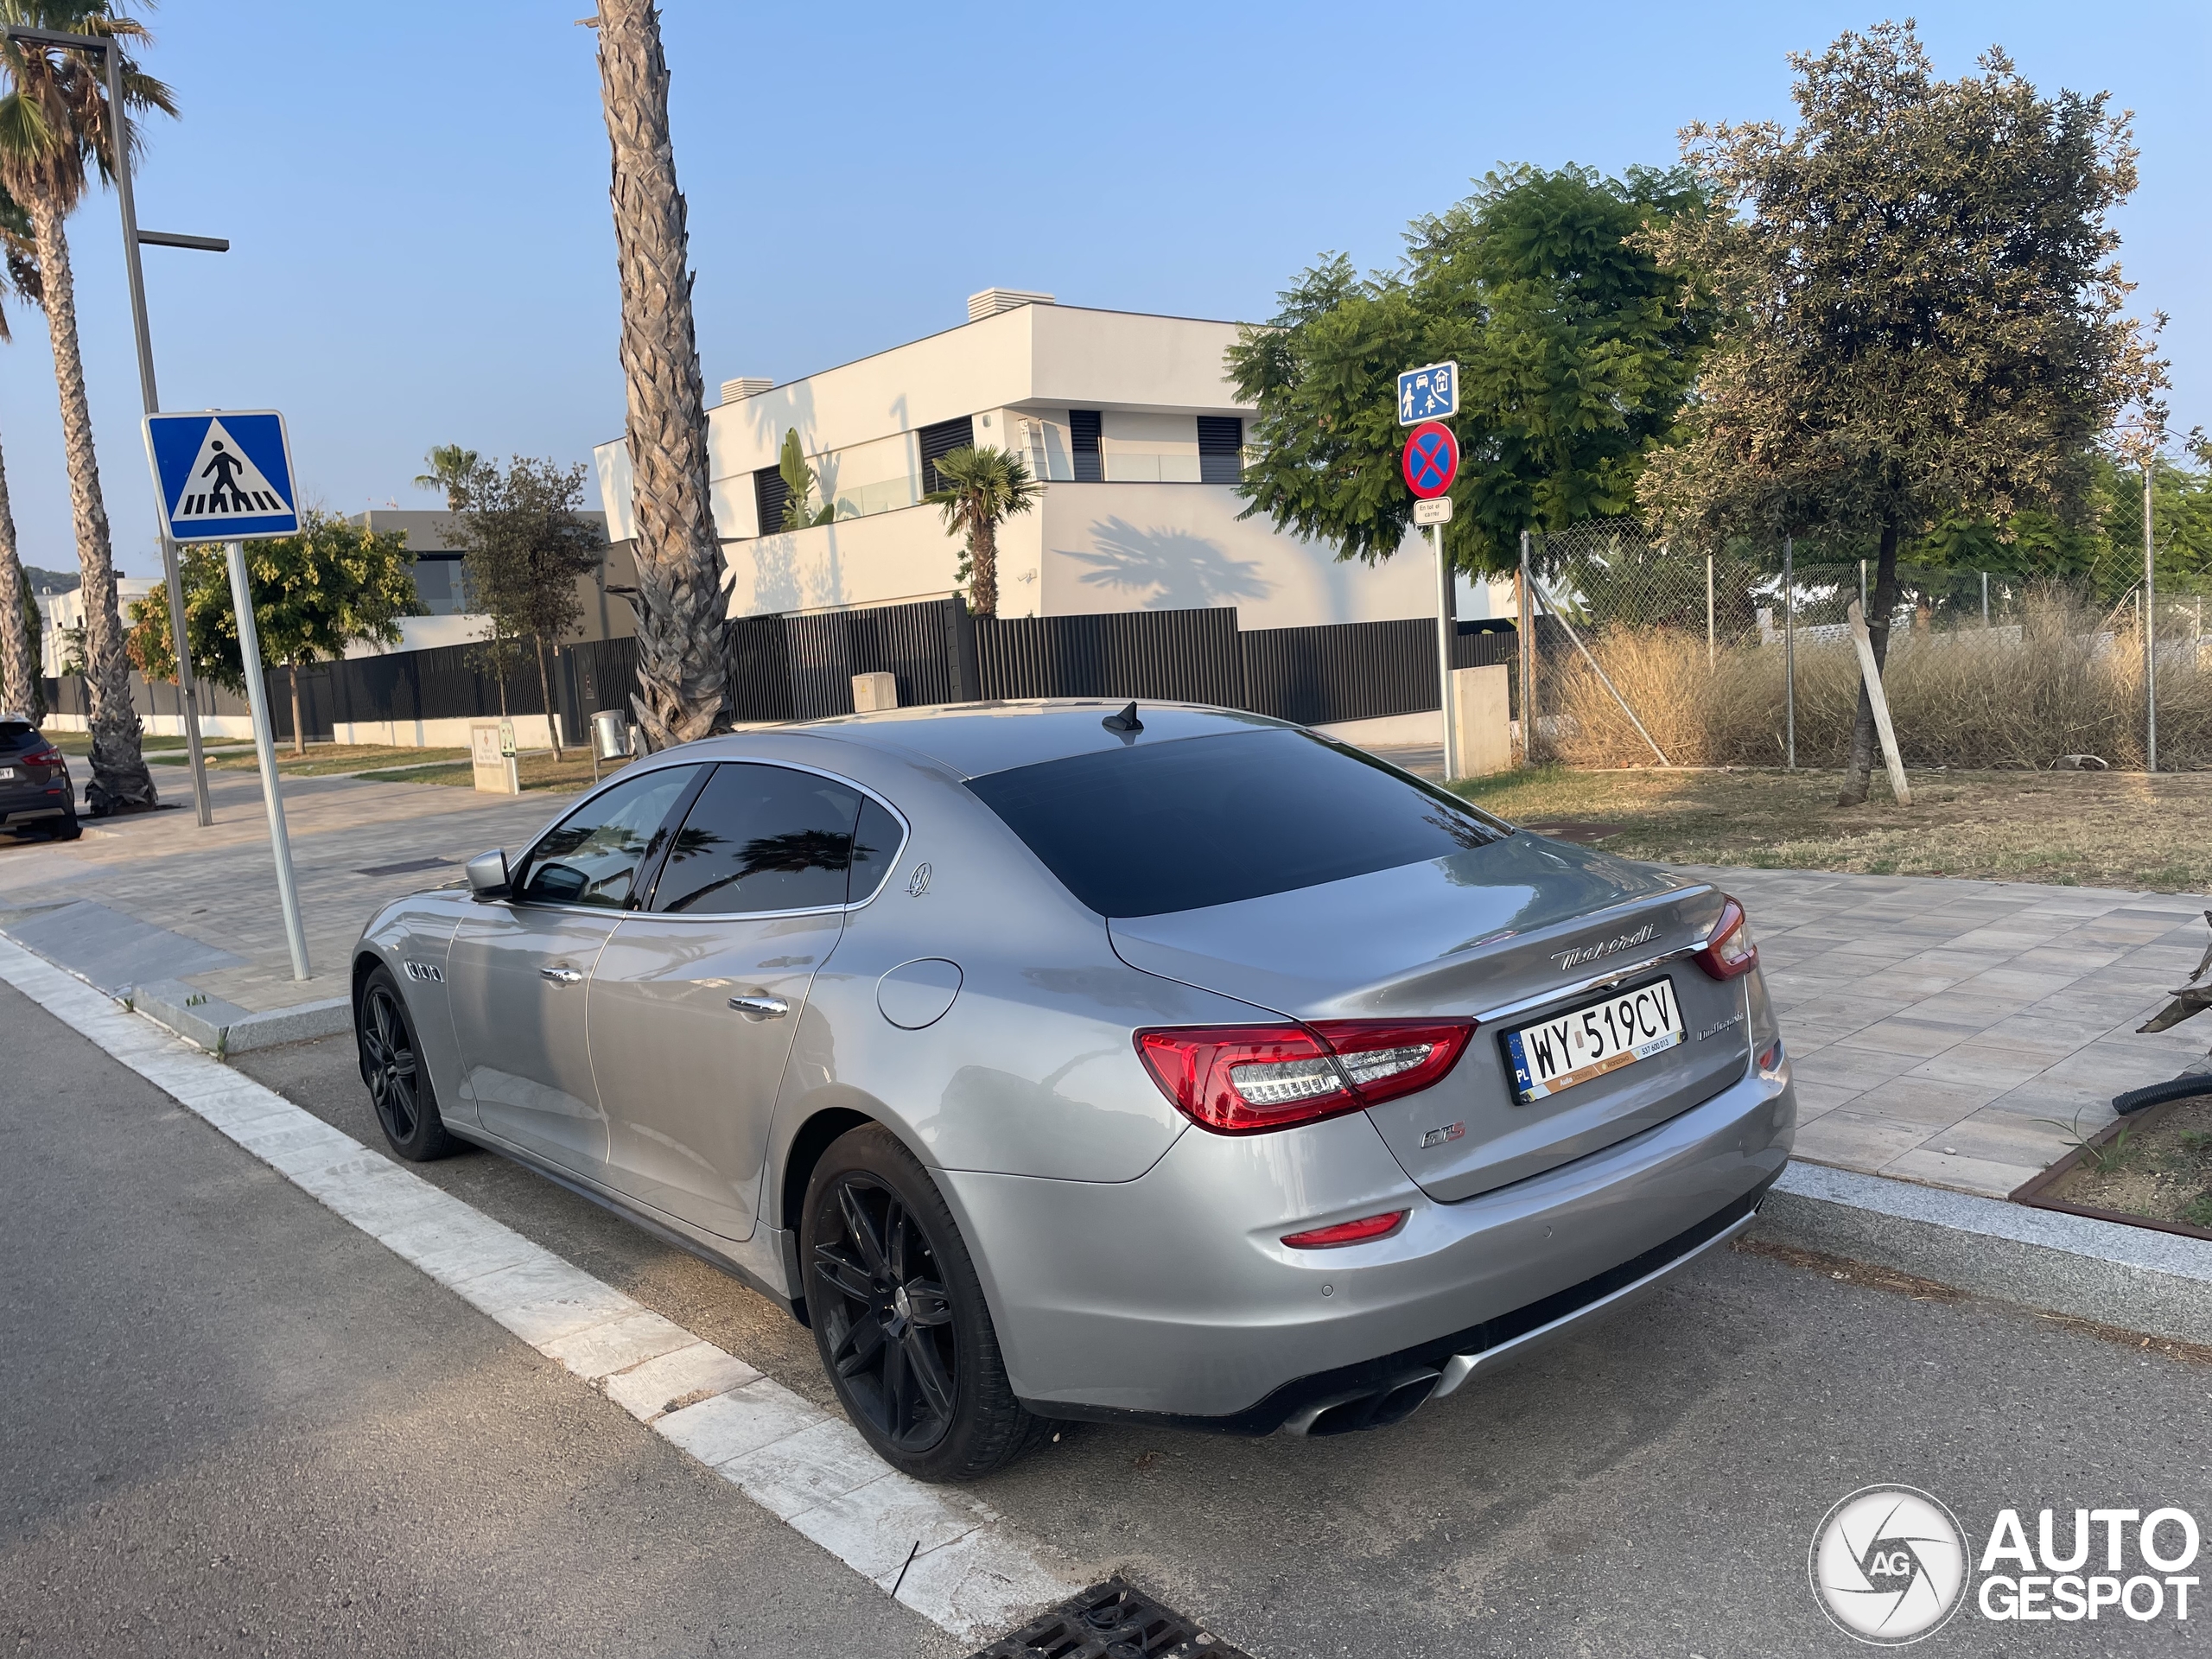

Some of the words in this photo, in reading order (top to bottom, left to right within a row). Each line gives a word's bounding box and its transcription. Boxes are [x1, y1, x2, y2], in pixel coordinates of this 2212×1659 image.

[1549, 923, 1662, 970] Maserati
[1529, 1020, 1573, 1079] WY
[1581, 986, 1670, 1058] 519CV
[1641, 1046, 1650, 1055] 537
[1651, 1042, 1661, 1052] 600
[1660, 1039, 1669, 1048] 013
[1516, 1068, 1529, 1084] PL
